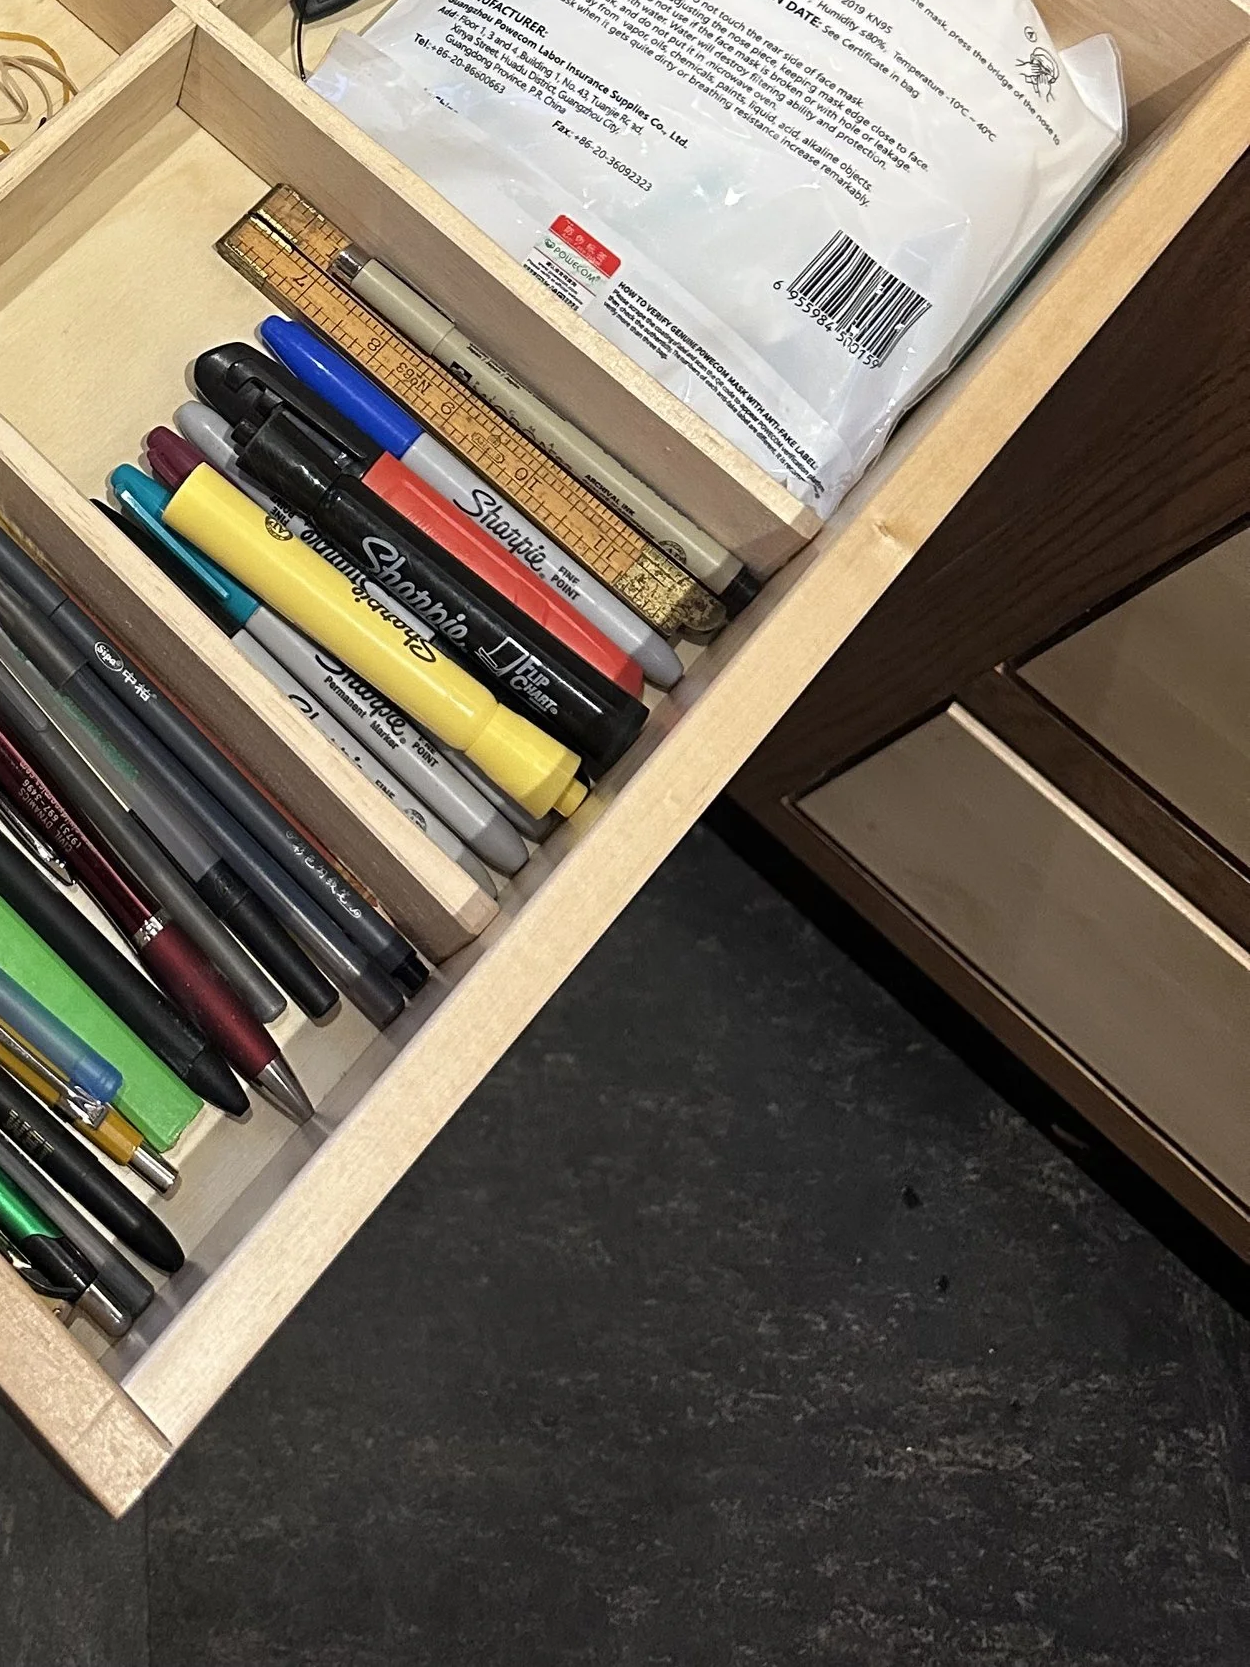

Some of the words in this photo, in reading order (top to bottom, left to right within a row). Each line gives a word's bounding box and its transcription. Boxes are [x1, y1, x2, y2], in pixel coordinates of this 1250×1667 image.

[865, 12, 893, 34] KN95
[784, 0, 822, 28] DATE:
[821, 24, 840, 40] See
[841, 38, 889, 74] Certificate
[888, 70, 899, 82] in
[899, 78, 920, 99] bag
[816, 0, 859, 31] Humidity
[893, 50, 944, 96] Temperature
[444, 33, 493, 69] Guangdong
[492, 62, 527, 92] Province,
[543, 95, 566, 114] China
[493, 18, 537, 49] Powecom
[537, 44, 566, 66] Labor
[564, 61, 609, 94] Insurance
[608, 89, 650, 120] Supplies
[649, 117, 667, 135] Co.,
[668, 130, 688, 149] Ltd.
[551, 119, 574, 138] Fax:
[574, 134, 652, 191] +86-20-36092323
[292, 274, 309, 287] 7
[772, 279, 784, 291] 6
[787, 289, 833, 333] 955984
[367, 338, 382, 352] 8
[617, 280, 638, 298] HOW
[635, 294, 647, 307] TO
[645, 303, 673, 327] VERIFY
[669, 324, 699, 350] GENUINE
[694, 345, 730, 378] POWECOM
[726, 375, 749, 397] MASK
[745, 393, 765, 414] WITH
[761, 412, 798, 448] ANTI-FAKE
[793, 445, 819, 470] LABEL:
[583, 473, 621, 504] ARCHIVAL
[620, 502, 635, 516] INK
[453, 489, 547, 572] Sharpie
[361, 536, 469, 648] Sharpie
[551, 575, 581, 601] POINT
[558, 565, 580, 585] FINE
[351, 585, 437, 664] Sharpie
[93, 642, 118, 668] Sipa
[514, 654, 551, 688] FLIP
[323, 675, 368, 720] Permanent
[369, 720, 400, 751] Marker
[510, 675, 558, 711] CHART
[411, 742, 439, 768] POINT
[18, 787, 54, 830] DYNAMICS
[54, 829, 73, 853] CIVIL
